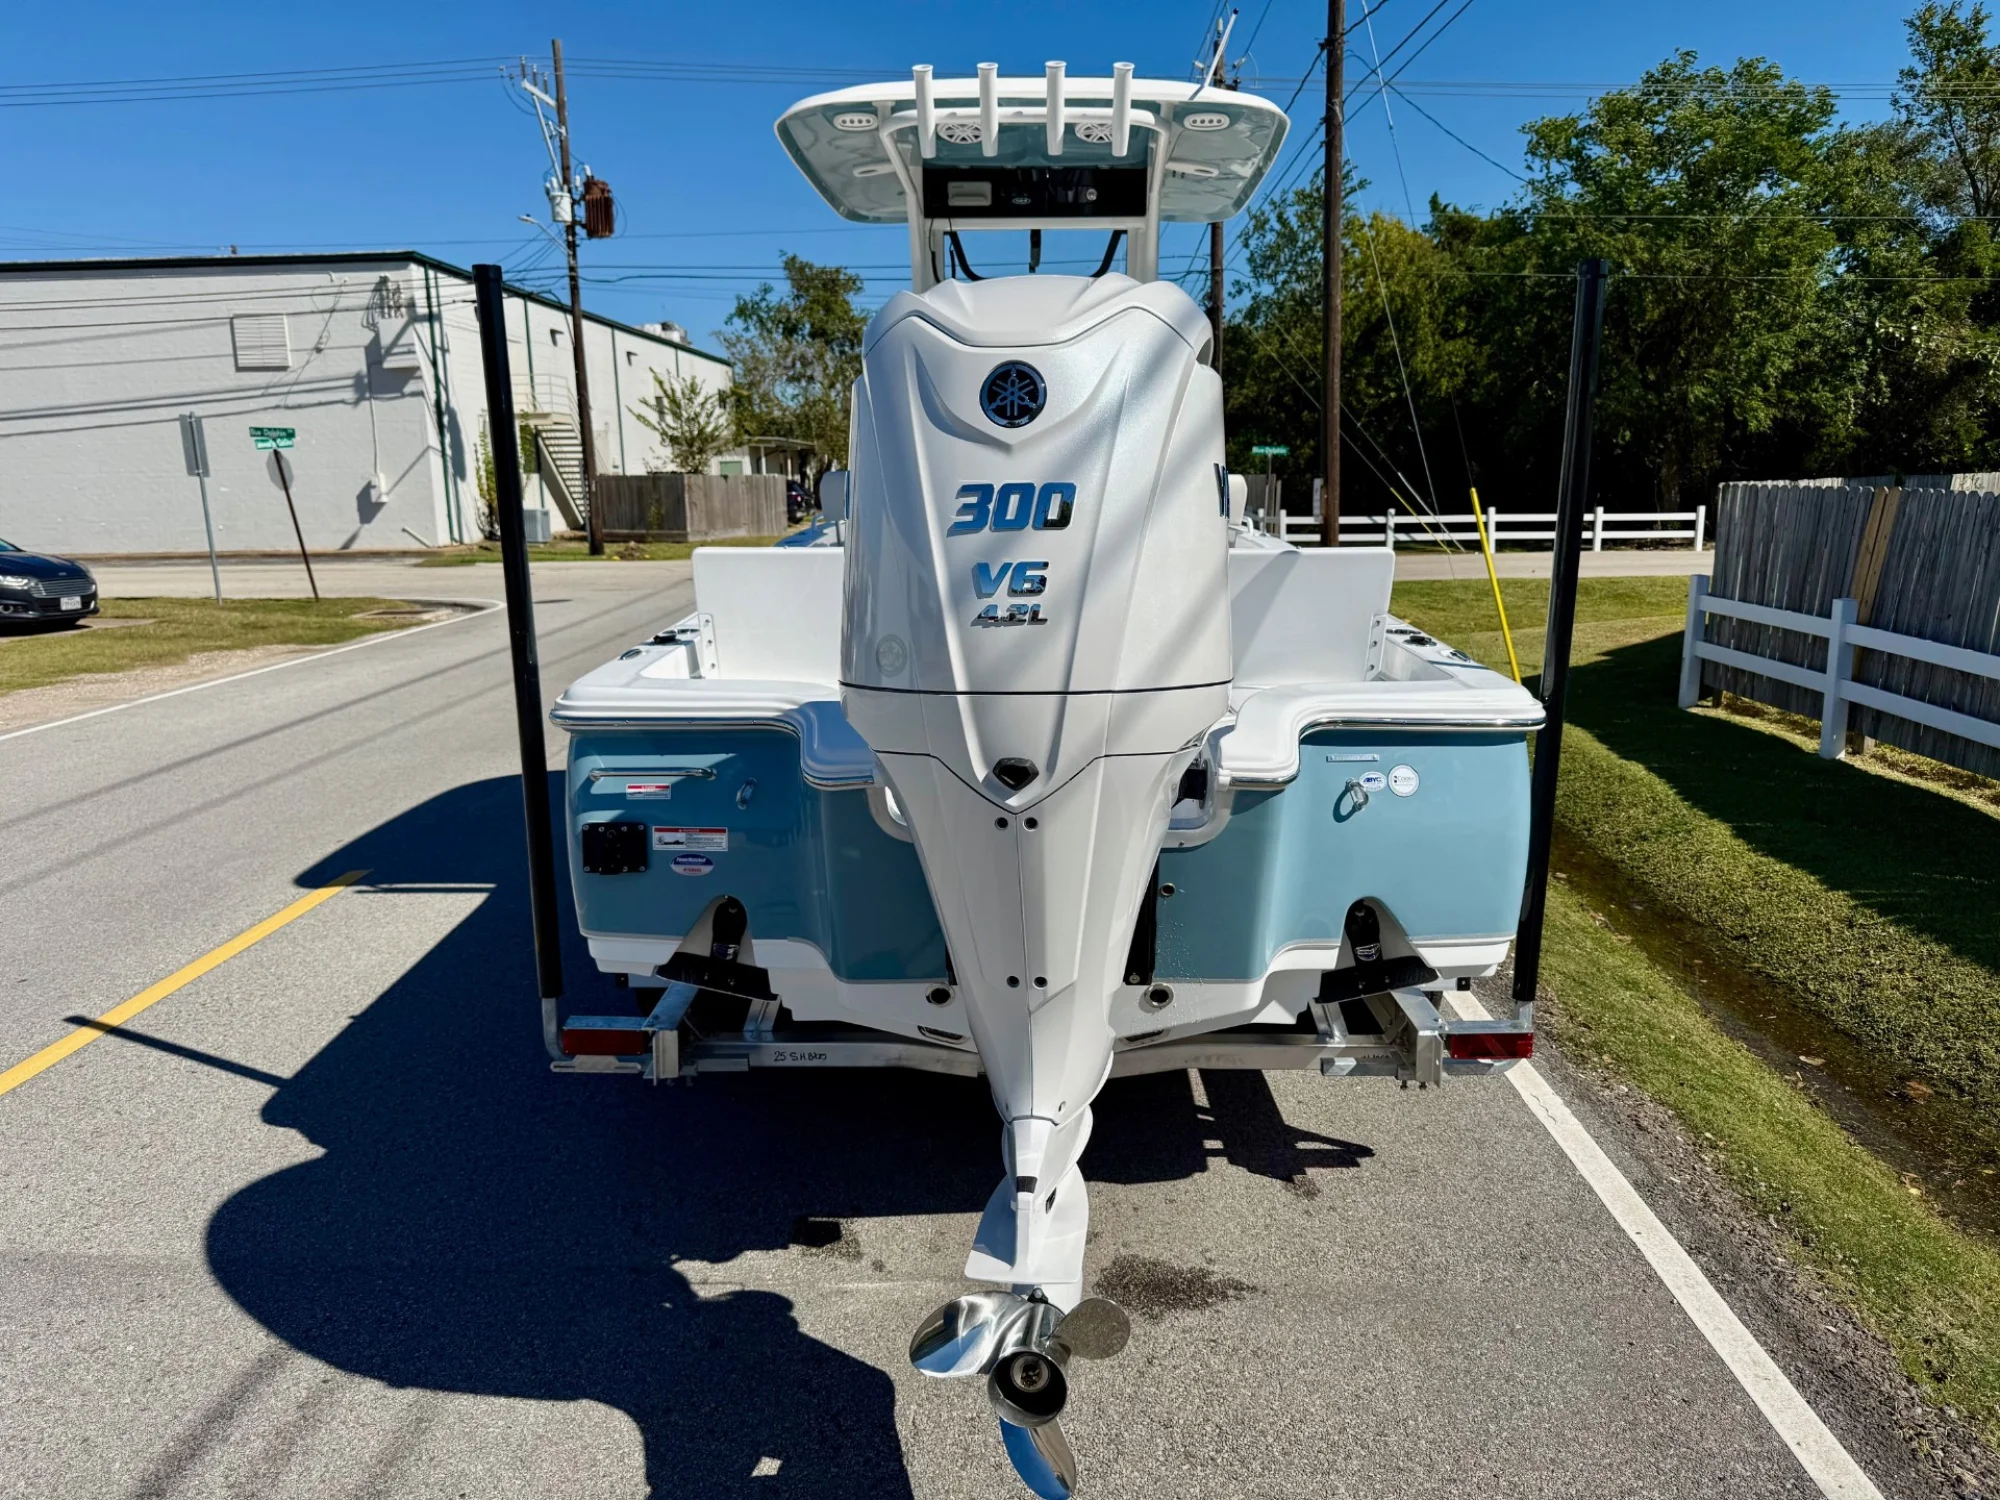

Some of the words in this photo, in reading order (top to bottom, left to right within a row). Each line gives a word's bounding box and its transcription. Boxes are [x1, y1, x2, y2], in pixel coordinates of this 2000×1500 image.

[947, 482, 1077, 537] 300
[971, 561, 1049, 599] V6
[774, 1050, 787, 1062] 25
